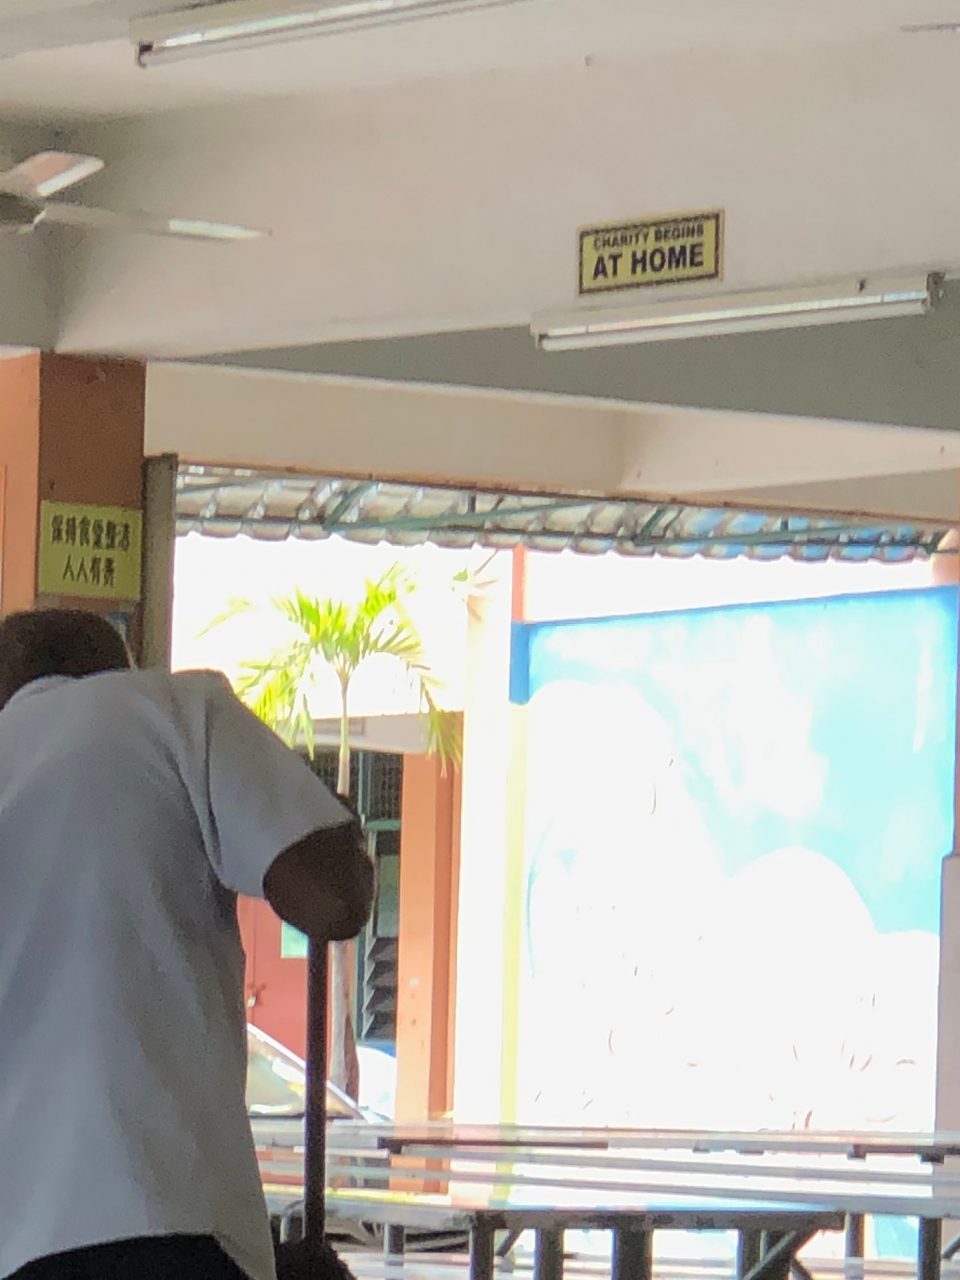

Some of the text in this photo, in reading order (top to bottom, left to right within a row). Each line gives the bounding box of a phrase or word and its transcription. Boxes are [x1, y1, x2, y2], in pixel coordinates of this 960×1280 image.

[594, 224, 704, 249] CHARITY BEGINS
[593, 243, 704, 280] AT HOME
